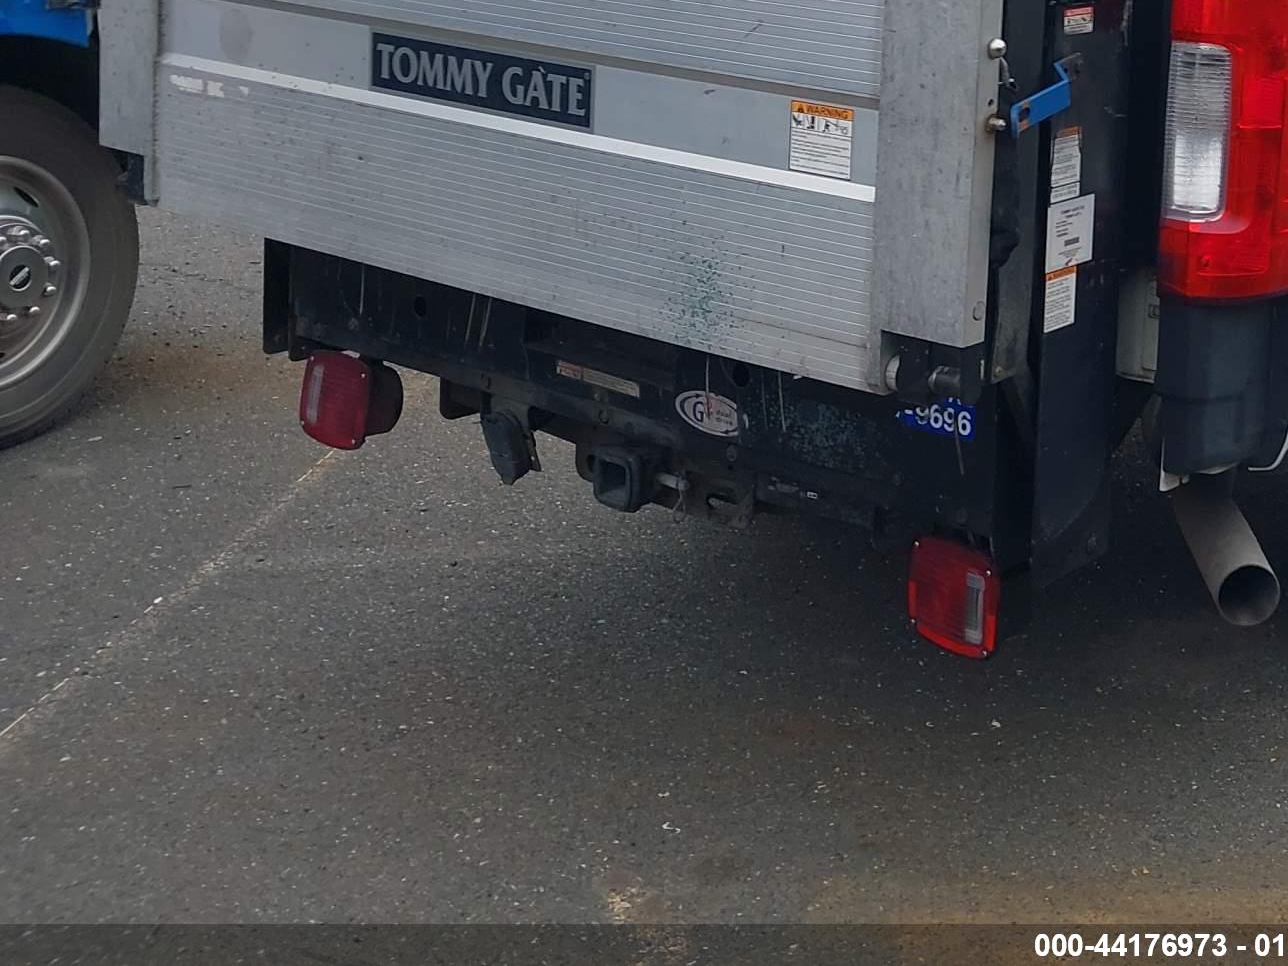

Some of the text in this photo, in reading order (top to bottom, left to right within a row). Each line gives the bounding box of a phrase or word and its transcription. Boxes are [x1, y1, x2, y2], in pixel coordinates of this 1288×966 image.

[376, 42, 586, 117] TOMMY GATE
[807, 105, 849, 120] WARNING
